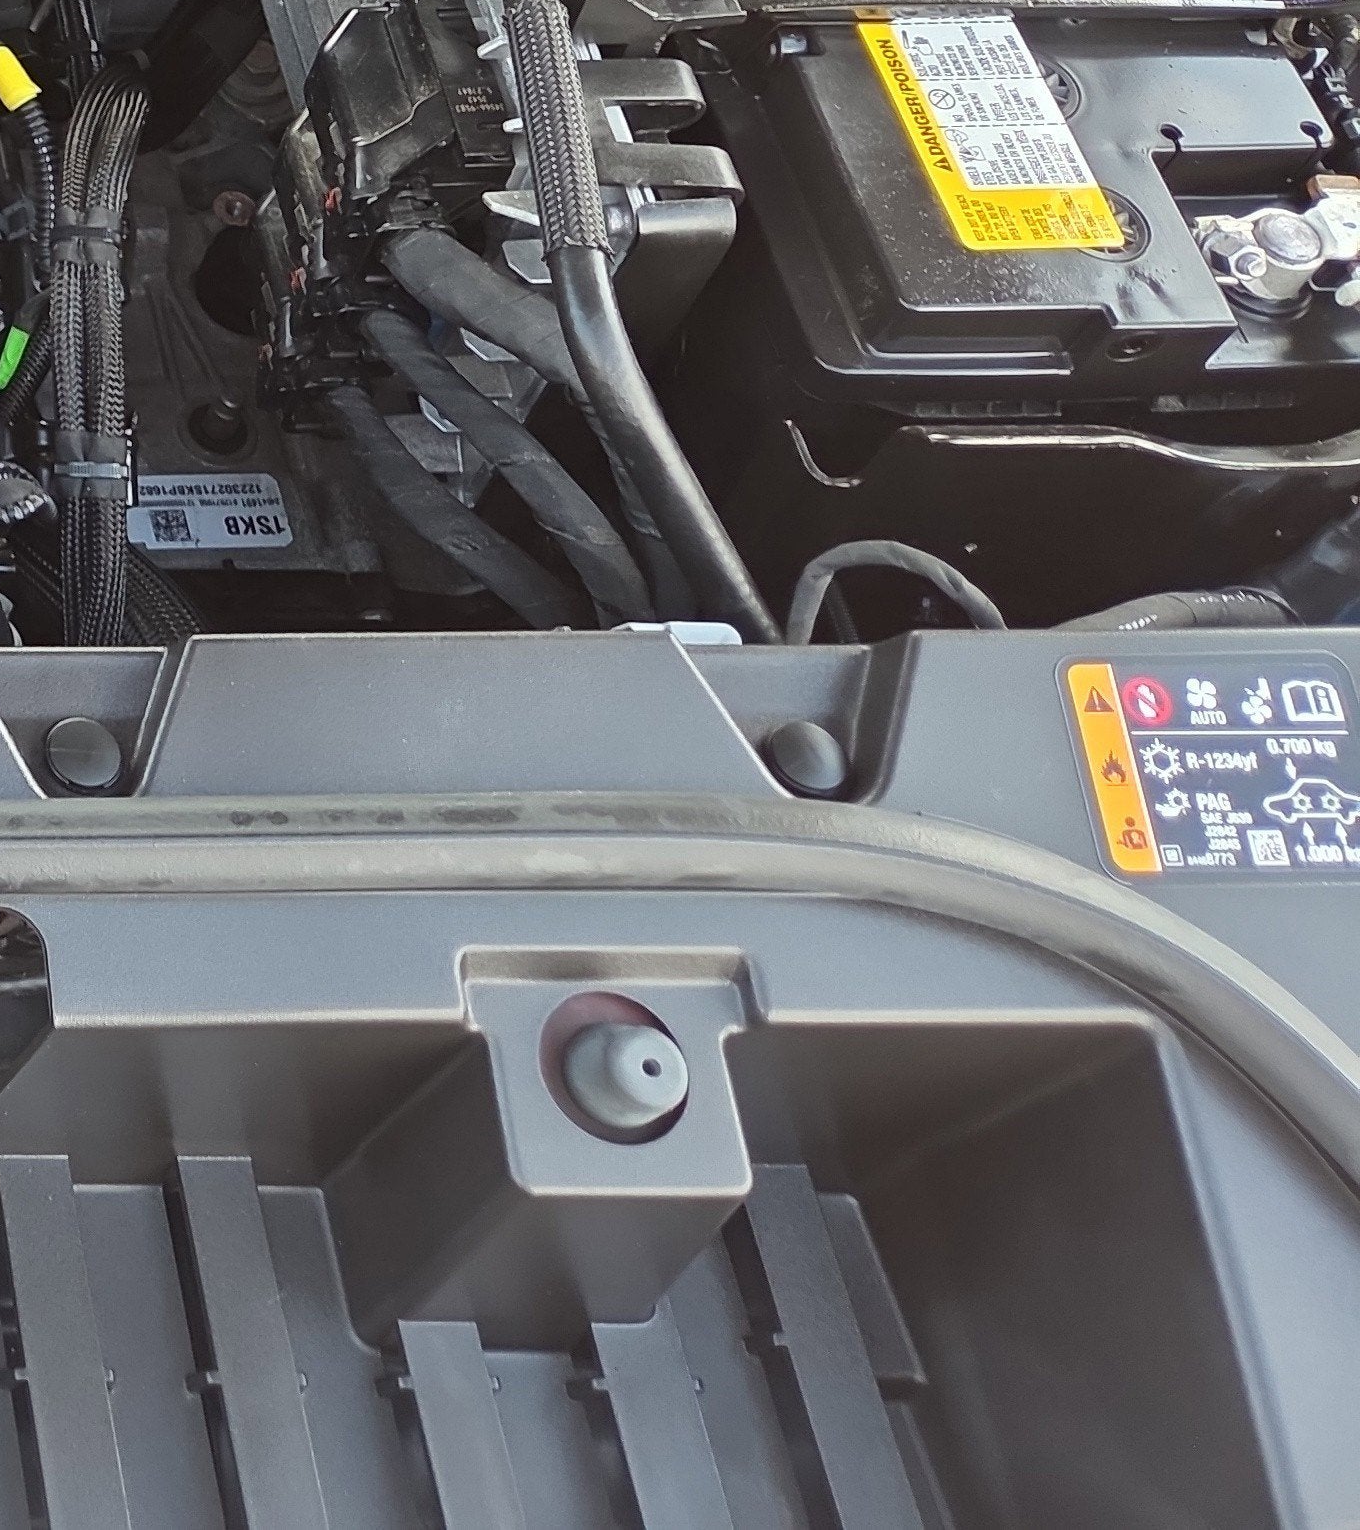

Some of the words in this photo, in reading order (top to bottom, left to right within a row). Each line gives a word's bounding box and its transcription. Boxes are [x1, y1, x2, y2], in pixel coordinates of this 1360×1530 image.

[874, 38, 946, 155] DANGER/POISON
[224, 513, 286, 537] 1SKB
[1189, 710, 1228, 726] AUTO
[1266, 738, 1312, 756] 0.700
[1314, 739, 1337, 759] kg
[1185, 751, 1259, 773] R-1234yf
[1195, 792, 1233, 812] PAG
[1294, 843, 1344, 863] 1.000
